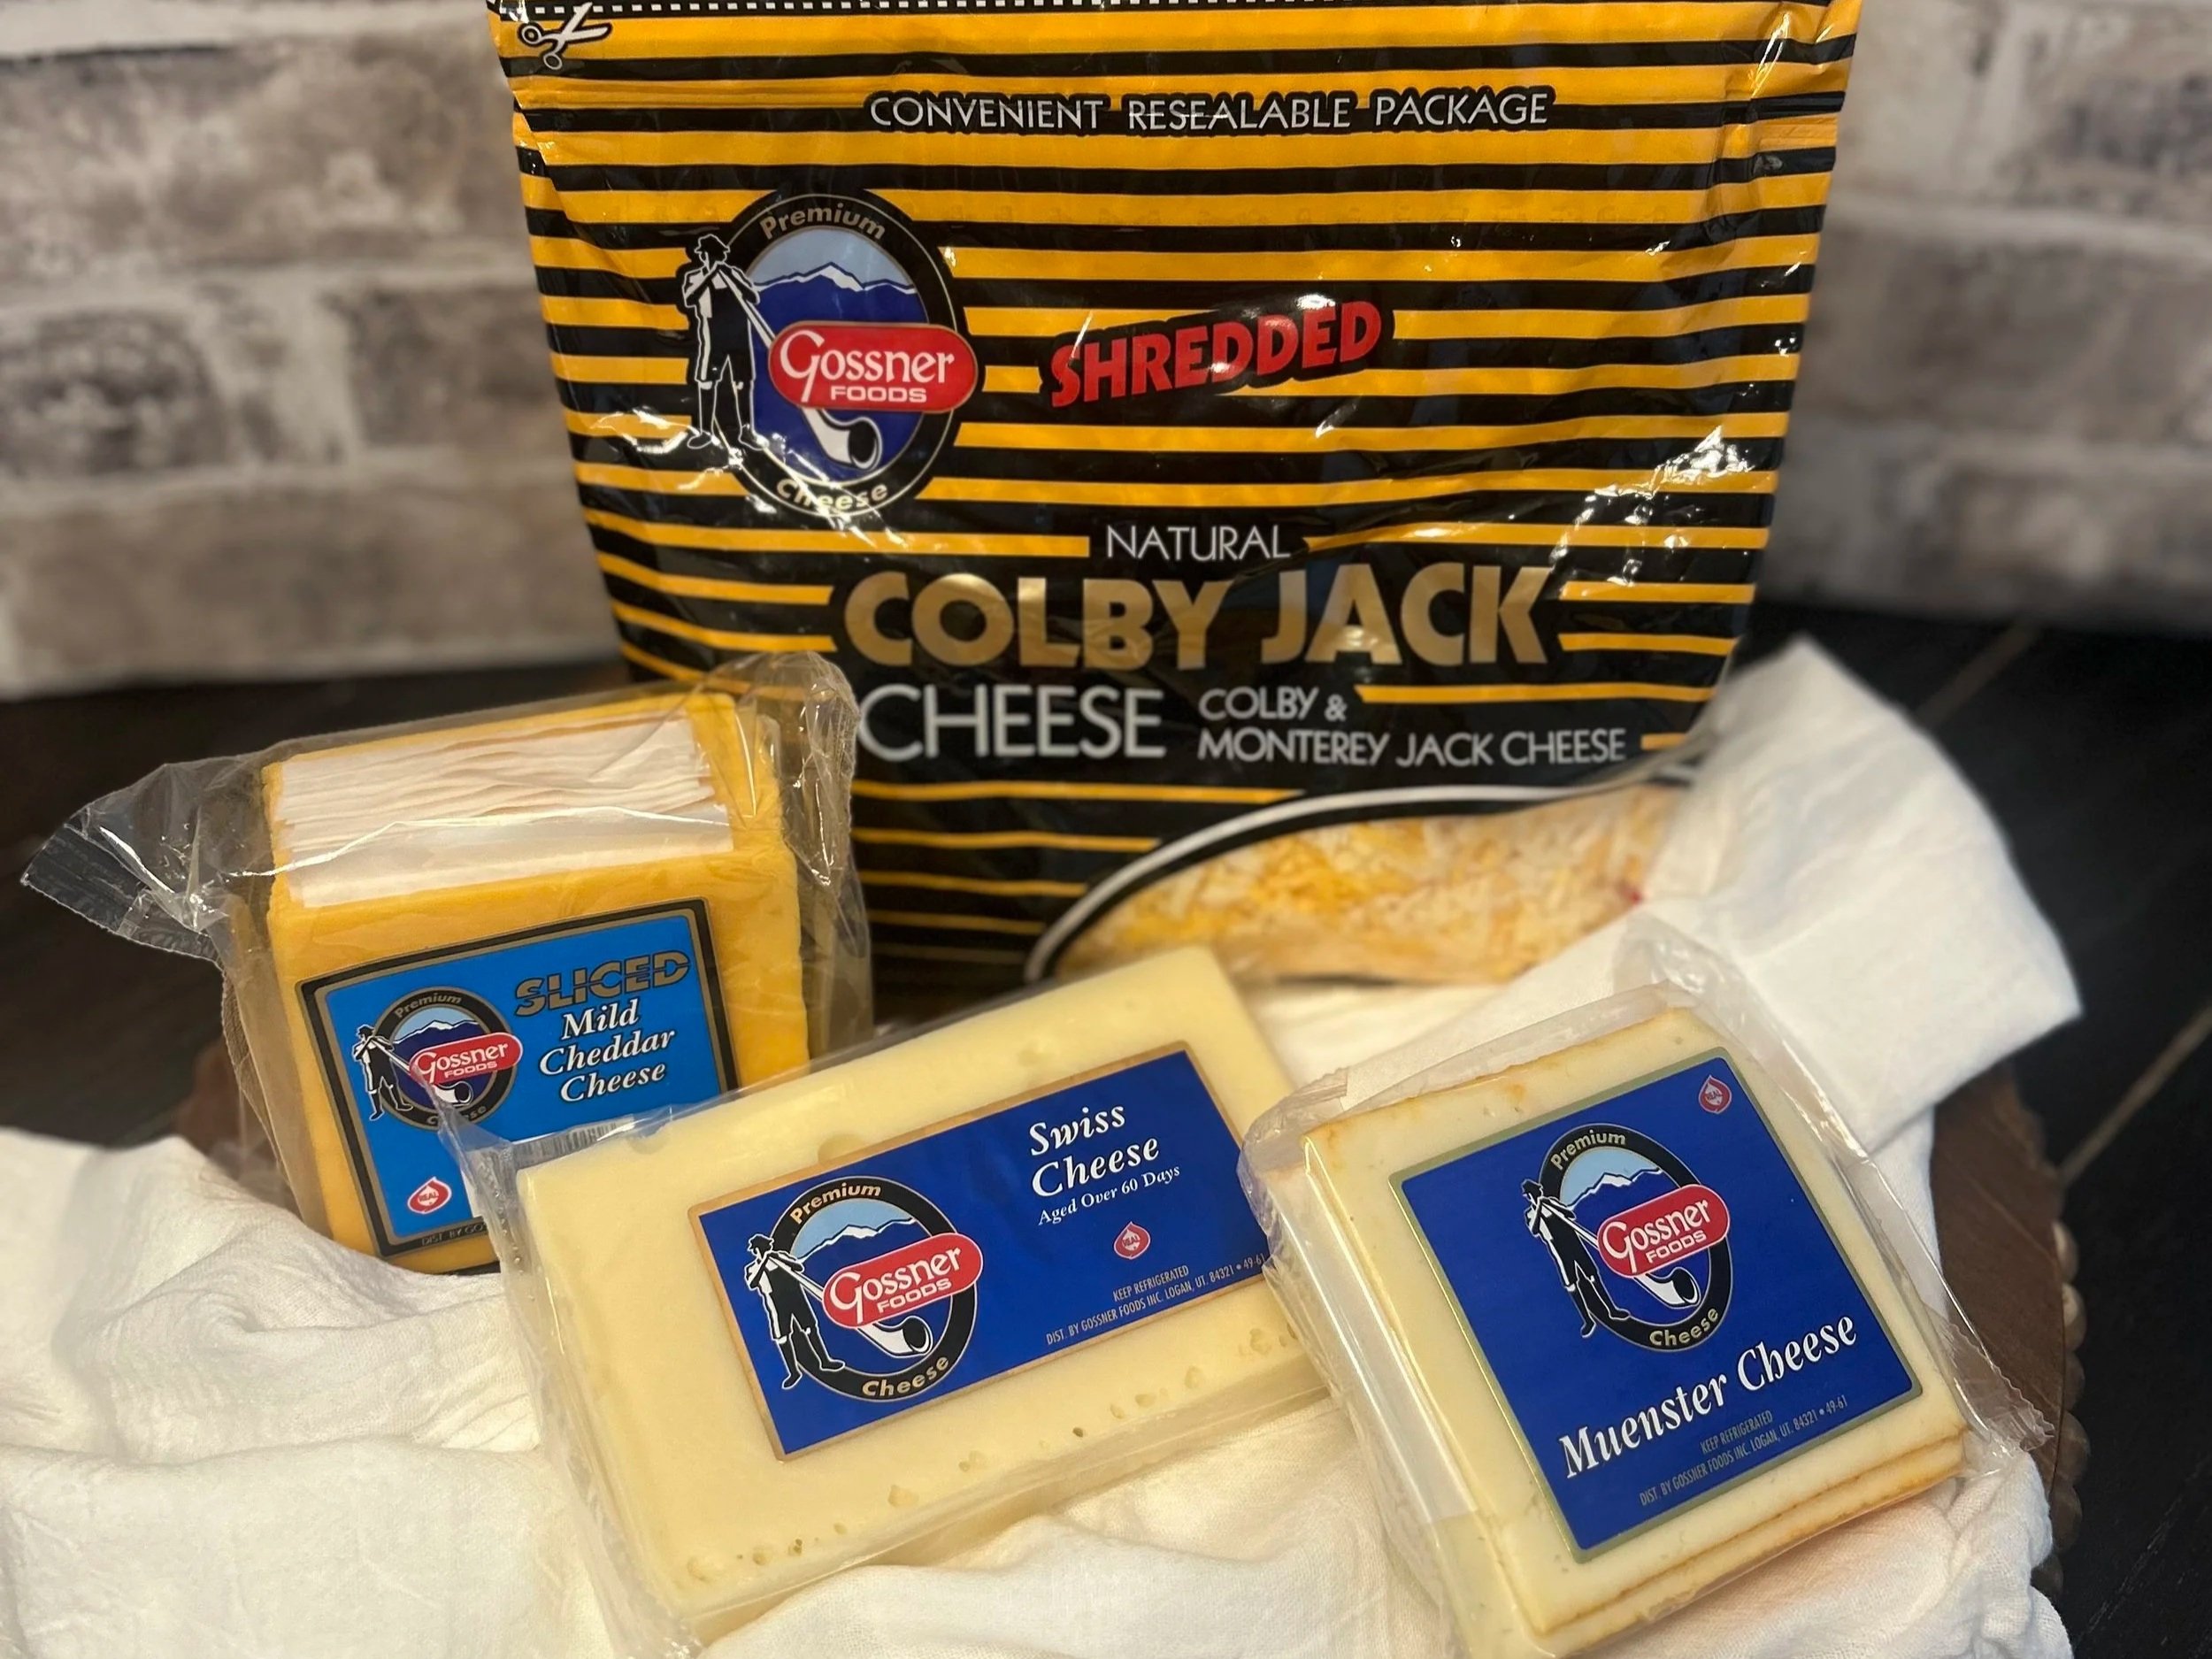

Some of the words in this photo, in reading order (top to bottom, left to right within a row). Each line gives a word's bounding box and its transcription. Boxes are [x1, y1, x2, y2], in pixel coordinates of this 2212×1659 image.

[871, 96, 1103, 129] CONVENIENT
[1128, 97, 1351, 130] RESEALABLE
[1376, 93, 1548, 127] PACKAGE
[760, 203, 886, 241] Premium
[780, 329, 956, 403] Gossner
[1051, 300, 1382, 408] SHREDDED
[830, 385, 927, 403] FOODS
[776, 479, 888, 513] Cheese
[1107, 525, 1291, 562] NATURAL
[844, 571, 1237, 671] COLBY
[1262, 562, 1554, 666] JACK
[856, 683, 1166, 762] CHEESE
[1198, 687, 1318, 721] COLBY
[1325, 694, 1348, 721] &
[1197, 728, 1390, 766] MONTEREY
[1395, 732, 1495, 766] JACK
[1500, 728, 1626, 765] CHEESE
[514, 949, 691, 1016] SLICED
[395, 993, 463, 1018] Premium
[561, 998, 639, 1041] Mild
[415, 1042, 509, 1084] Gossner
[444, 1061, 498, 1079] FOODS
[539, 1030, 676, 1075] Cheddar
[559, 1063, 666, 1102] Cheese
[1029, 1105, 1125, 1156] Swiss
[1550, 1129, 1627, 1171] Premium
[1032, 1138, 1159, 1197] Cheese
[789, 1181, 882, 1225] Premium
[1038, 1198, 1078, 1225] Aged
[1080, 1186, 1118, 1208] Over
[1121, 1178, 1139, 1194] 60
[1141, 1165, 1180, 1188] Days
[1602, 1198, 1711, 1274] Gossner
[1645, 1229, 1708, 1264] FOODS
[829, 1246, 962, 1324] Gossner
[876, 1277, 953, 1314] FOODS
[1112, 1285, 1133, 1302] KEEP
[1133, 1264, 1189, 1295] REFRIGERATED
[1046, 1328, 1067, 1346] DIST.
[1068, 1324, 1079, 1337] BY
[1080, 1310, 1118, 1332] GOSSNER
[1119, 1299, 1147, 1317] FOODS
[1147, 1294, 1164, 1308] INC.
[1164, 1280, 1195, 1301] LOGAN,
[1194, 1274, 1208, 1289] UT.
[1209, 1265, 1235, 1283] 84321
[1649, 1307, 1719, 1347] Cheese
[862, 1356, 949, 1397] Cheese
[1558, 1373, 1728, 1479] Muenster
[1737, 1316, 1857, 1392] Cheese
[1639, 1488, 1661, 1507] DIST.
[1660, 1482, 1672, 1496] BY
[1671, 1463, 1709, 1491] GOSSNER
[1708, 1449, 1735, 1473] FOODS
[1734, 1444, 1751, 1460] INC.
[1750, 1430, 1781, 1453] LOGAN,
[1779, 1422, 1794, 1438] UT.
[1793, 1409, 1819, 1431] 84321
[1825, 1394, 1848, 1416] 49-61
[1699, 1438, 1720, 1455] KEEP
[1720, 1409, 1774, 1445] REFRIGERATED
